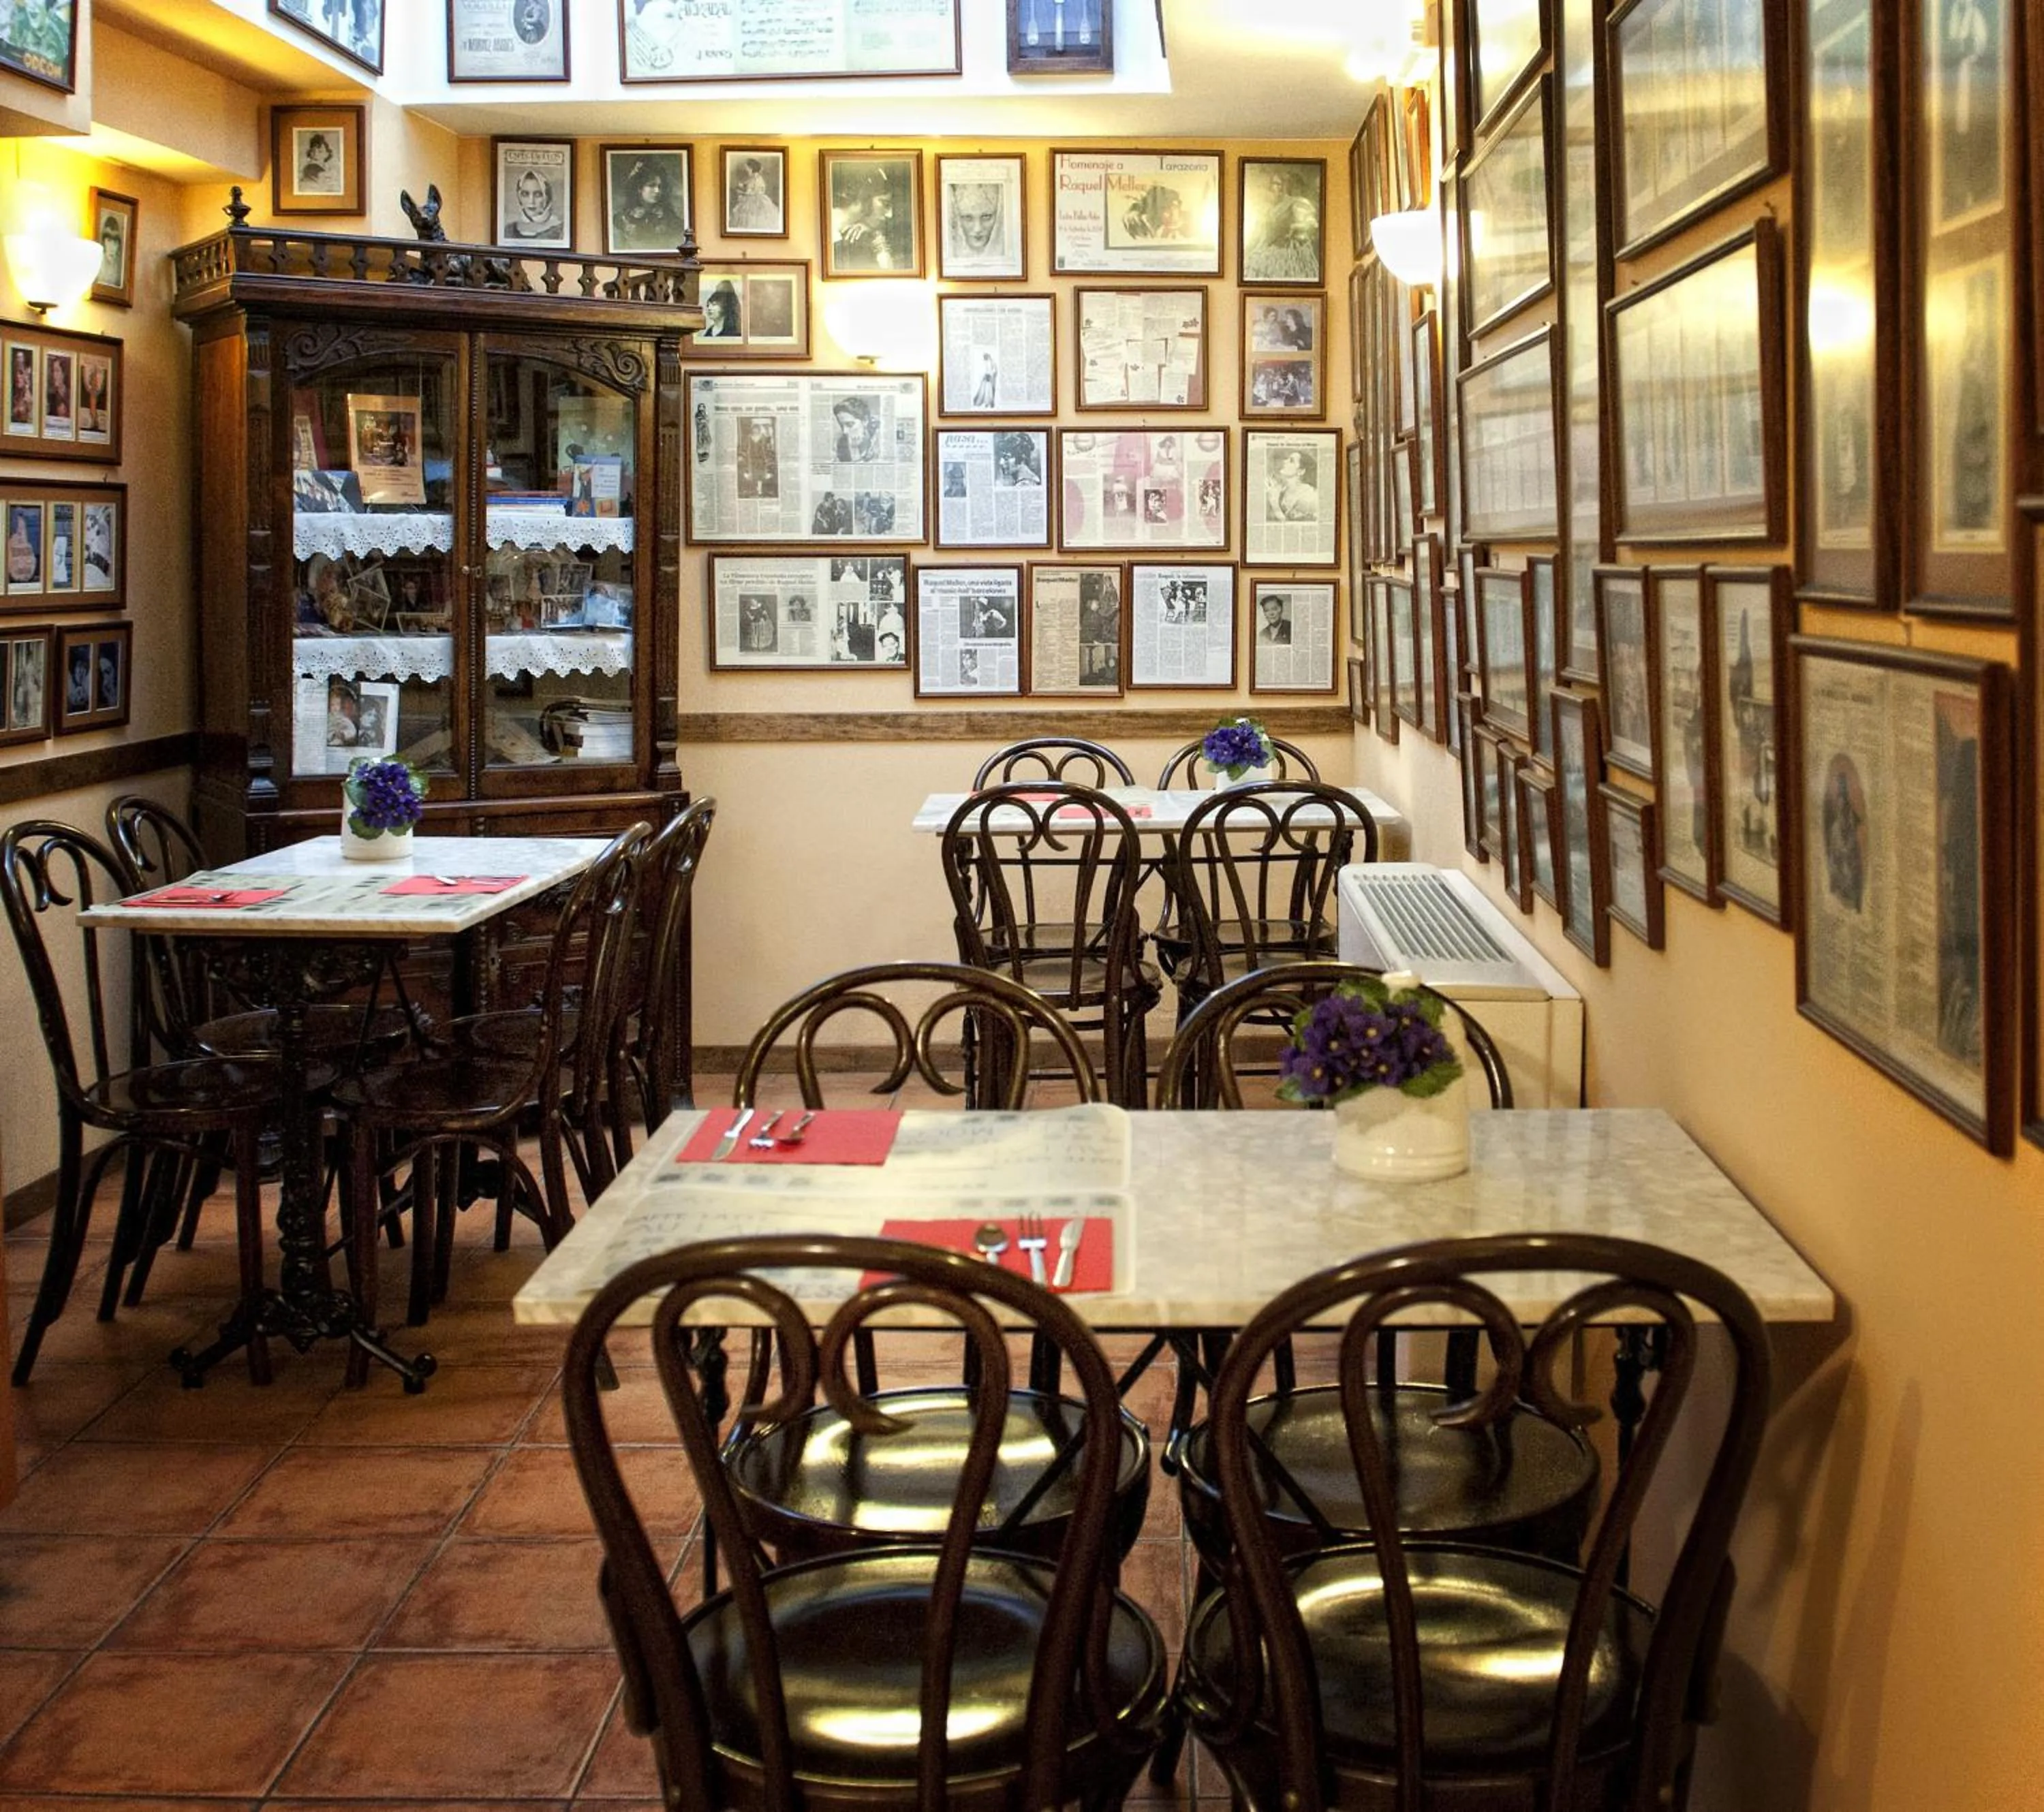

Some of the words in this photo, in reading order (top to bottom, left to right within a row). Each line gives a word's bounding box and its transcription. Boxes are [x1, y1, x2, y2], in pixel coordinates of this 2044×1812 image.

[1060, 154, 1114, 170] Homenaje
[1158, 156, 1208, 172] Tarazona
[1059, 174, 1102, 194] Raquel
